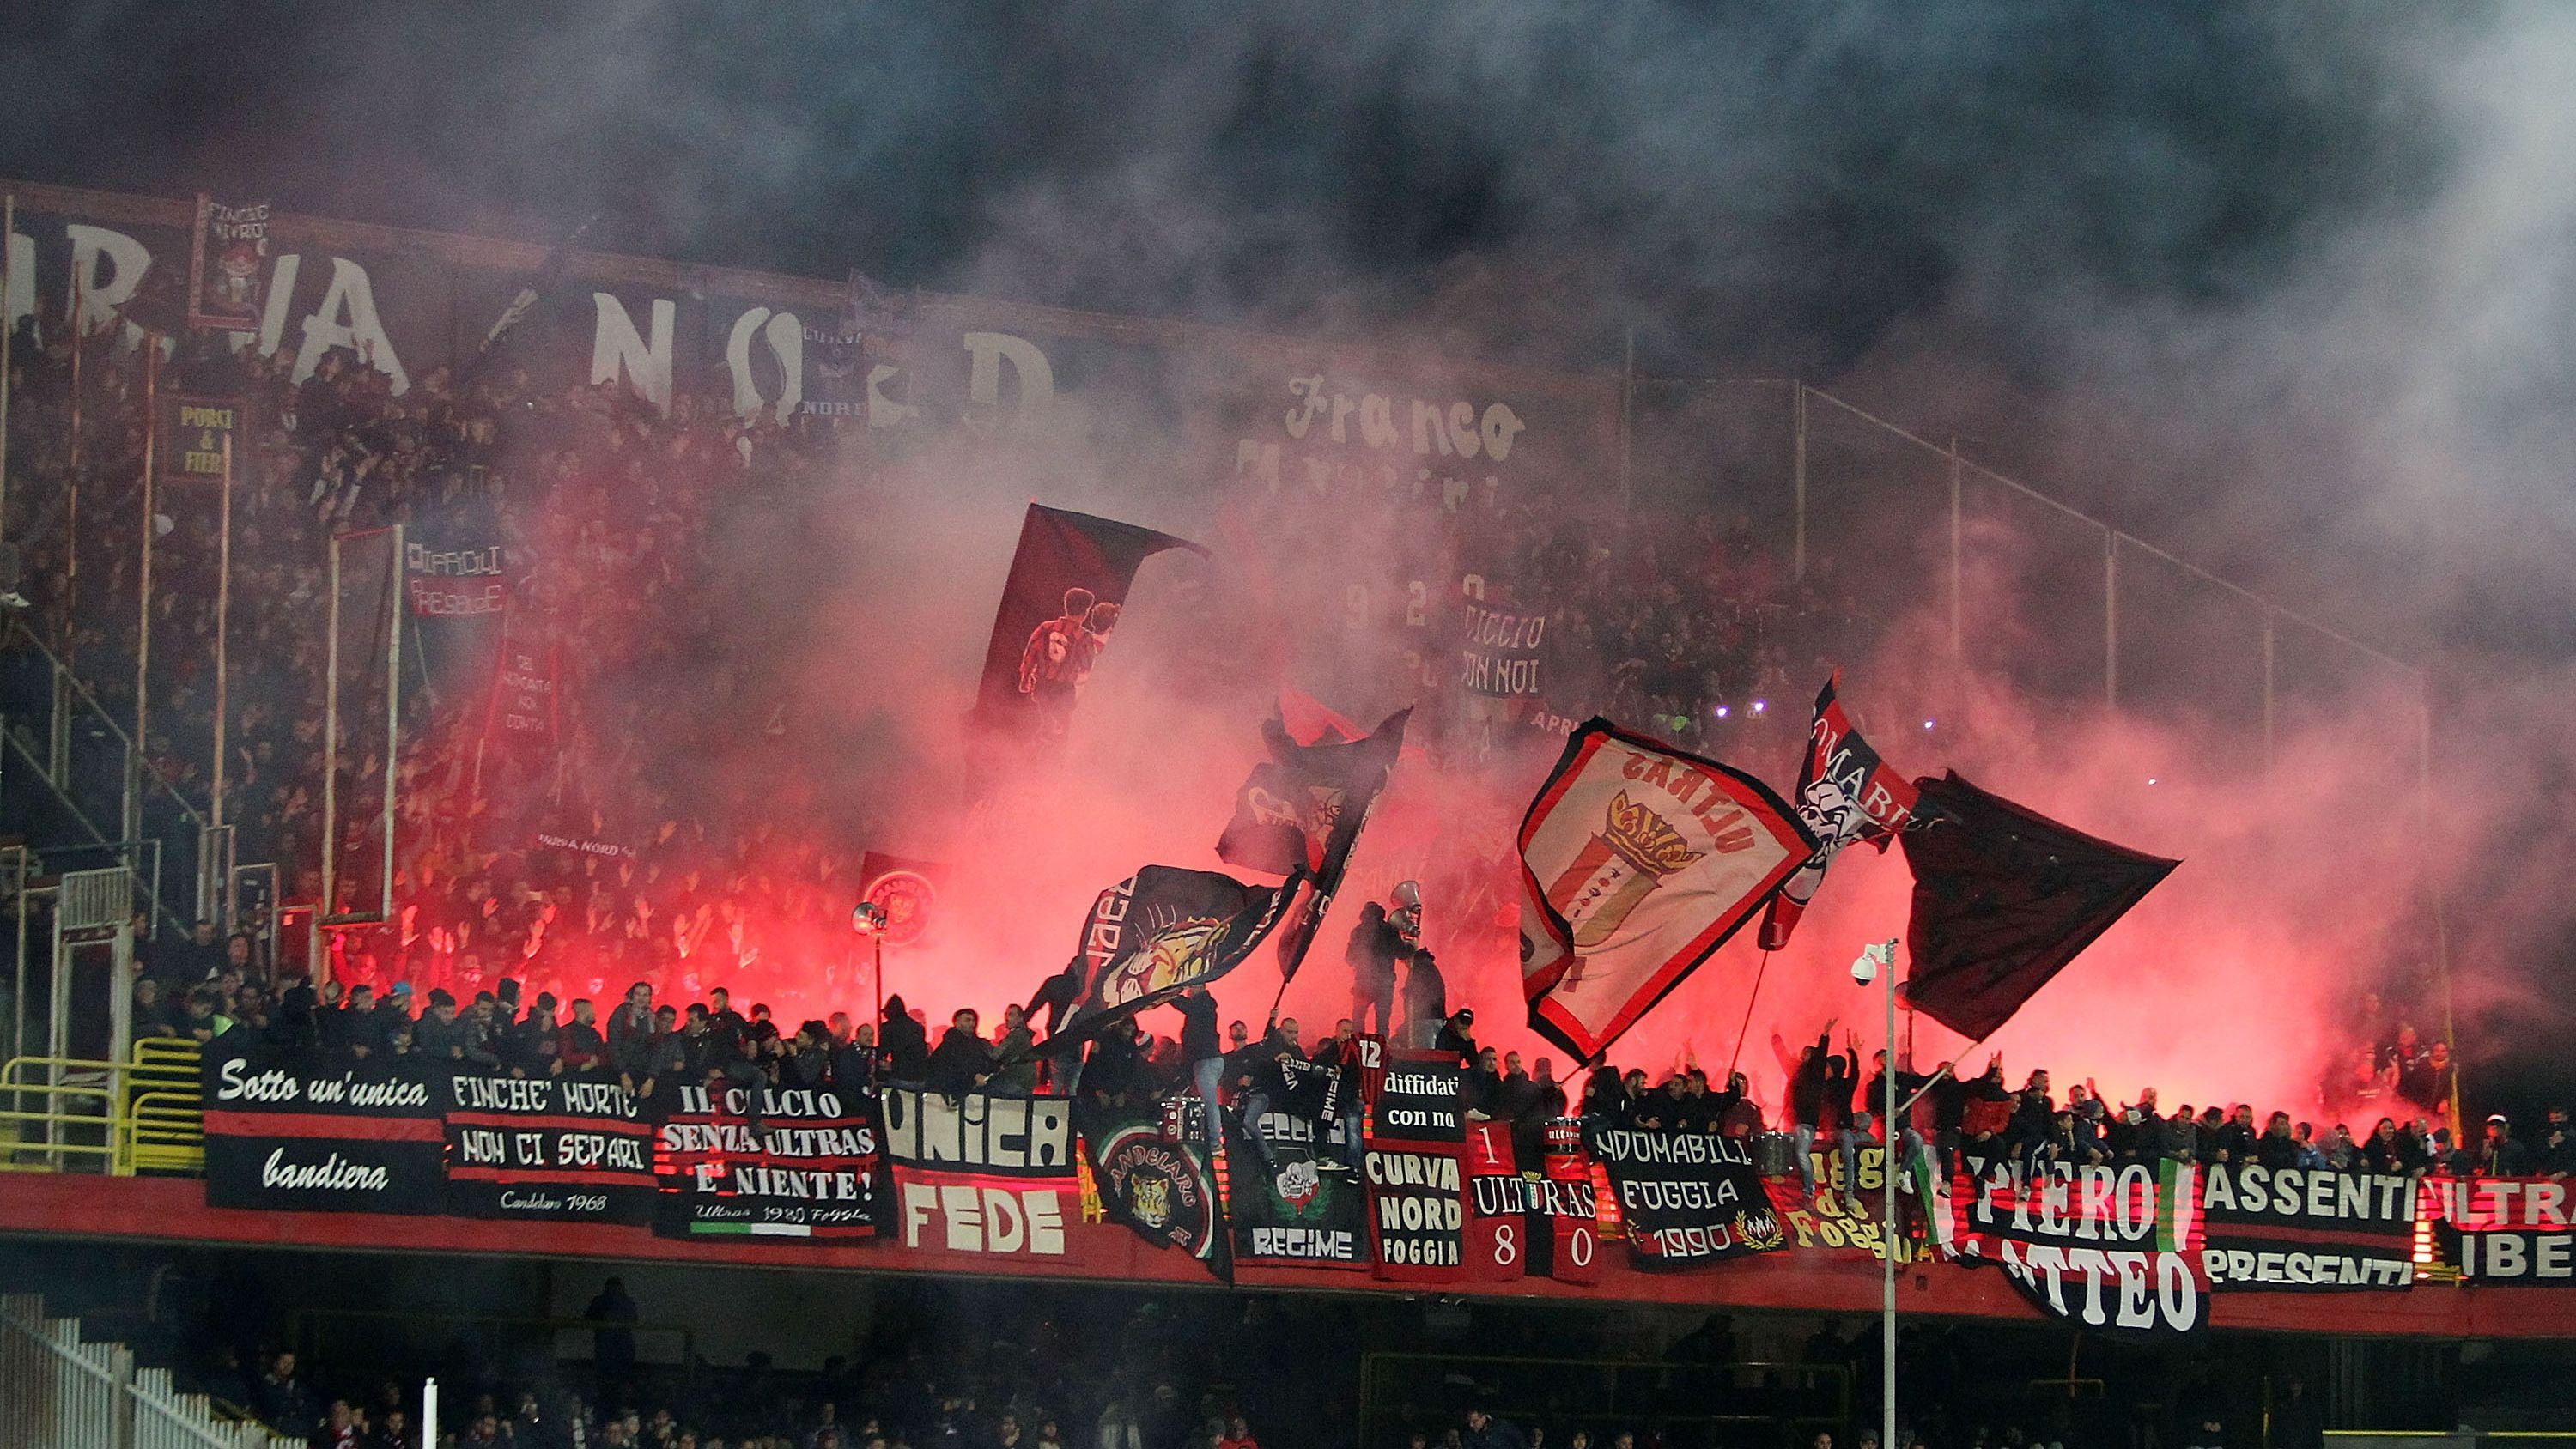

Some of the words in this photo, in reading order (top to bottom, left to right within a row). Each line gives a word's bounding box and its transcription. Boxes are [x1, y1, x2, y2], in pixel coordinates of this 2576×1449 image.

[1286, 374, 1526, 461] Franco
[1495, 658, 1540, 694] NOI
[581, 840, 619, 856] NORD
[1358, 1040, 1381, 1069] 12
[217, 1058, 301, 1103] Sotto
[307, 1070, 429, 1107] un'unica
[453, 1075, 553, 1111] FINCHE'
[679, 1085, 715, 1113] IL
[724, 1087, 843, 1119] CLCIO
[1388, 1109, 1428, 1126] con
[461, 1129, 506, 1165] NON
[515, 1132, 545, 1166] CI
[557, 1133, 645, 1170] SEPARI
[662, 1123, 762, 1153] SENZA
[763, 1127, 877, 1157] ULTRAS
[1478, 1125, 1500, 1165] 1
[262, 1146, 390, 1191] bandiera
[735, 1167, 872, 1202] NIENTE!
[1364, 1151, 1461, 1191] CURVA
[565, 1193, 609, 1213] 1968
[1472, 1177, 1598, 1219] ULTRAS
[1621, 1178, 1740, 1212] FOGGIA
[2203, 1162, 2418, 1223] ASSENTI
[694, 1204, 751, 1219] Ultras
[762, 1205, 806, 1223] 1980
[902, 1181, 1066, 1255] FEDE
[1379, 1197, 1462, 1231] NORD
[1382, 1238, 1460, 1266] FOGGIA
[1493, 1223, 1516, 1266] 8
[1570, 1227, 1594, 1267] 0
[1652, 1223, 1732, 1258] 1990
[2202, 1249, 2414, 1288] PRESENTI
